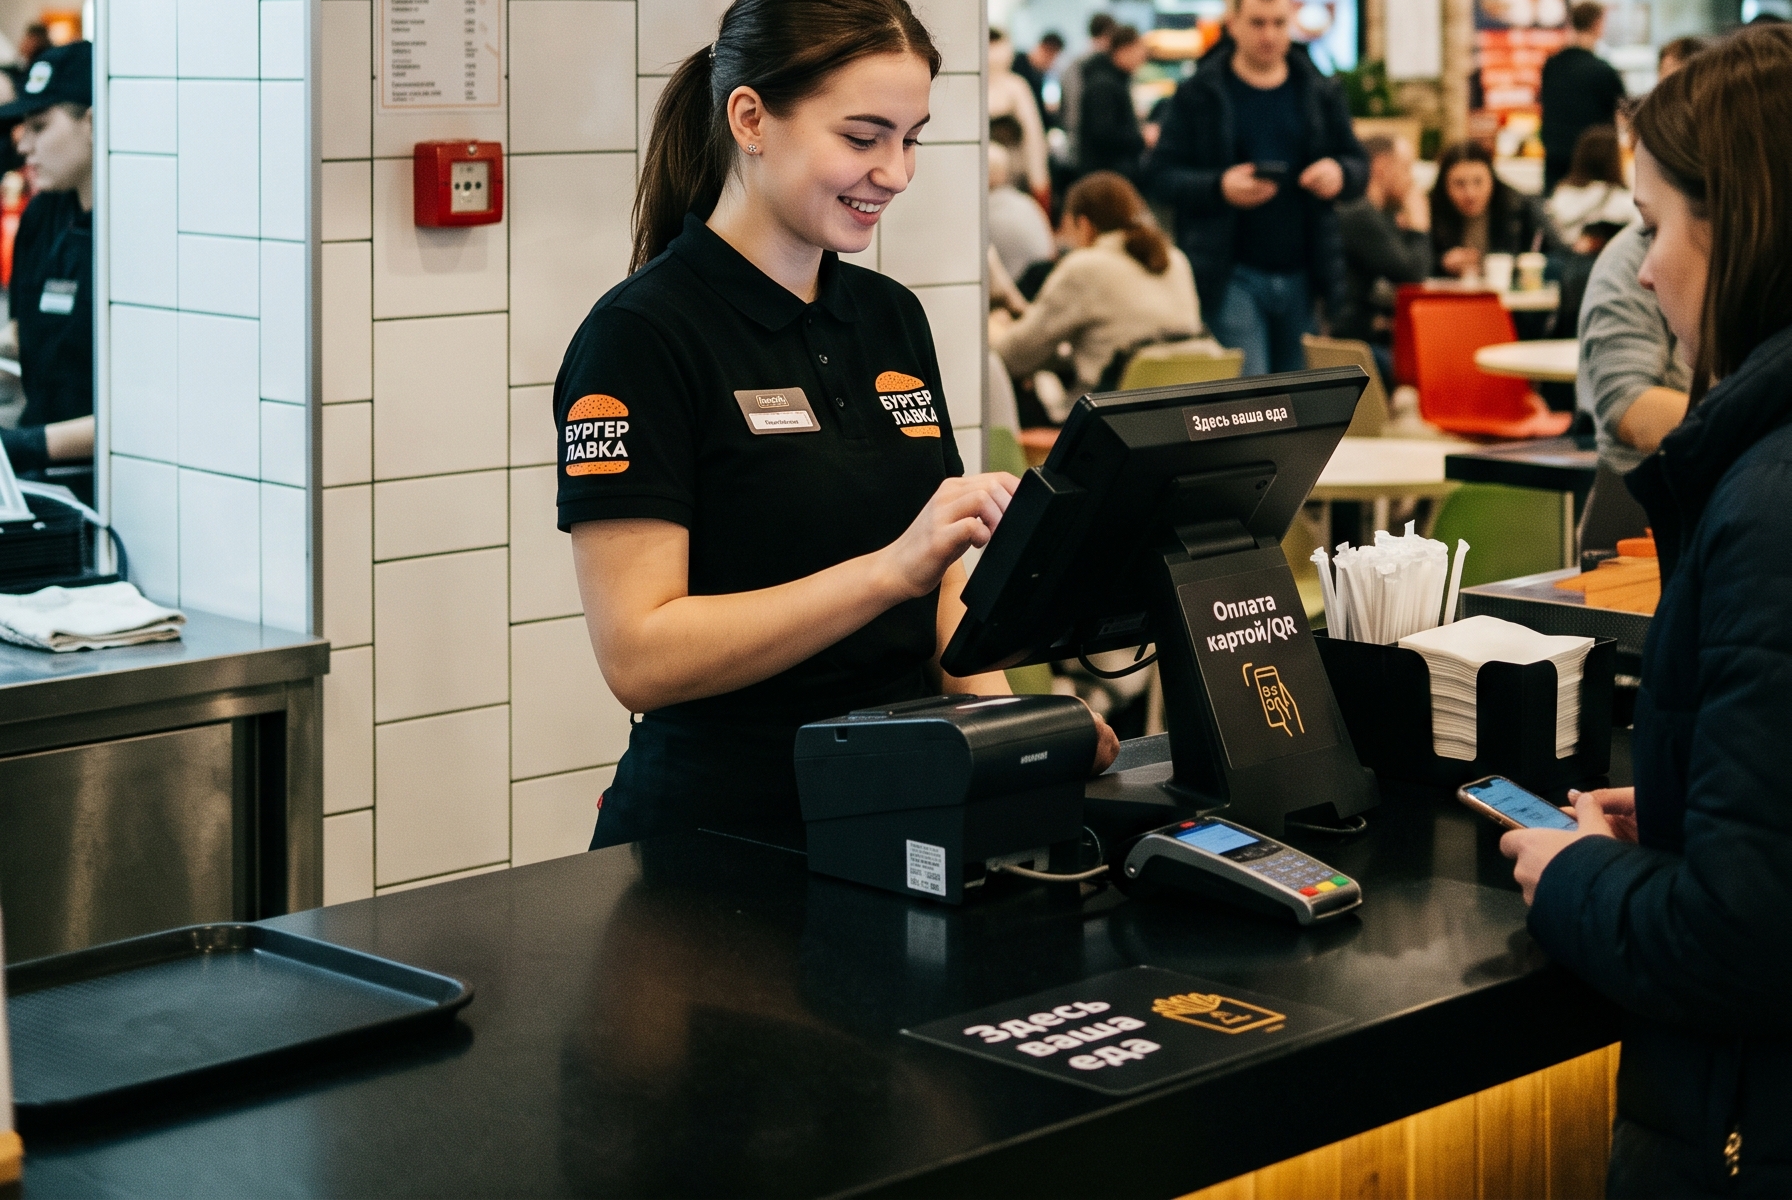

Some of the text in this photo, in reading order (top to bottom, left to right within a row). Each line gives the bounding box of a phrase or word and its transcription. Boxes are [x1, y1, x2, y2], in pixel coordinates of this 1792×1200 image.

[879, 390, 931, 410] БУРГЕР
[892, 407, 938, 425] ЛАВКА
[1192, 407, 1288, 431] Здесь ваша еда
[565, 421, 629, 443] БУРГЕР
[565, 440, 628, 462] ЛАВКА
[1213, 596, 1276, 621] Оплата
[1206, 616, 1298, 653] картой/QR
[962, 1001, 1111, 1044] Здесь
[1016, 1016, 1146, 1057] ваша
[1068, 1038, 1162, 1071] еда
